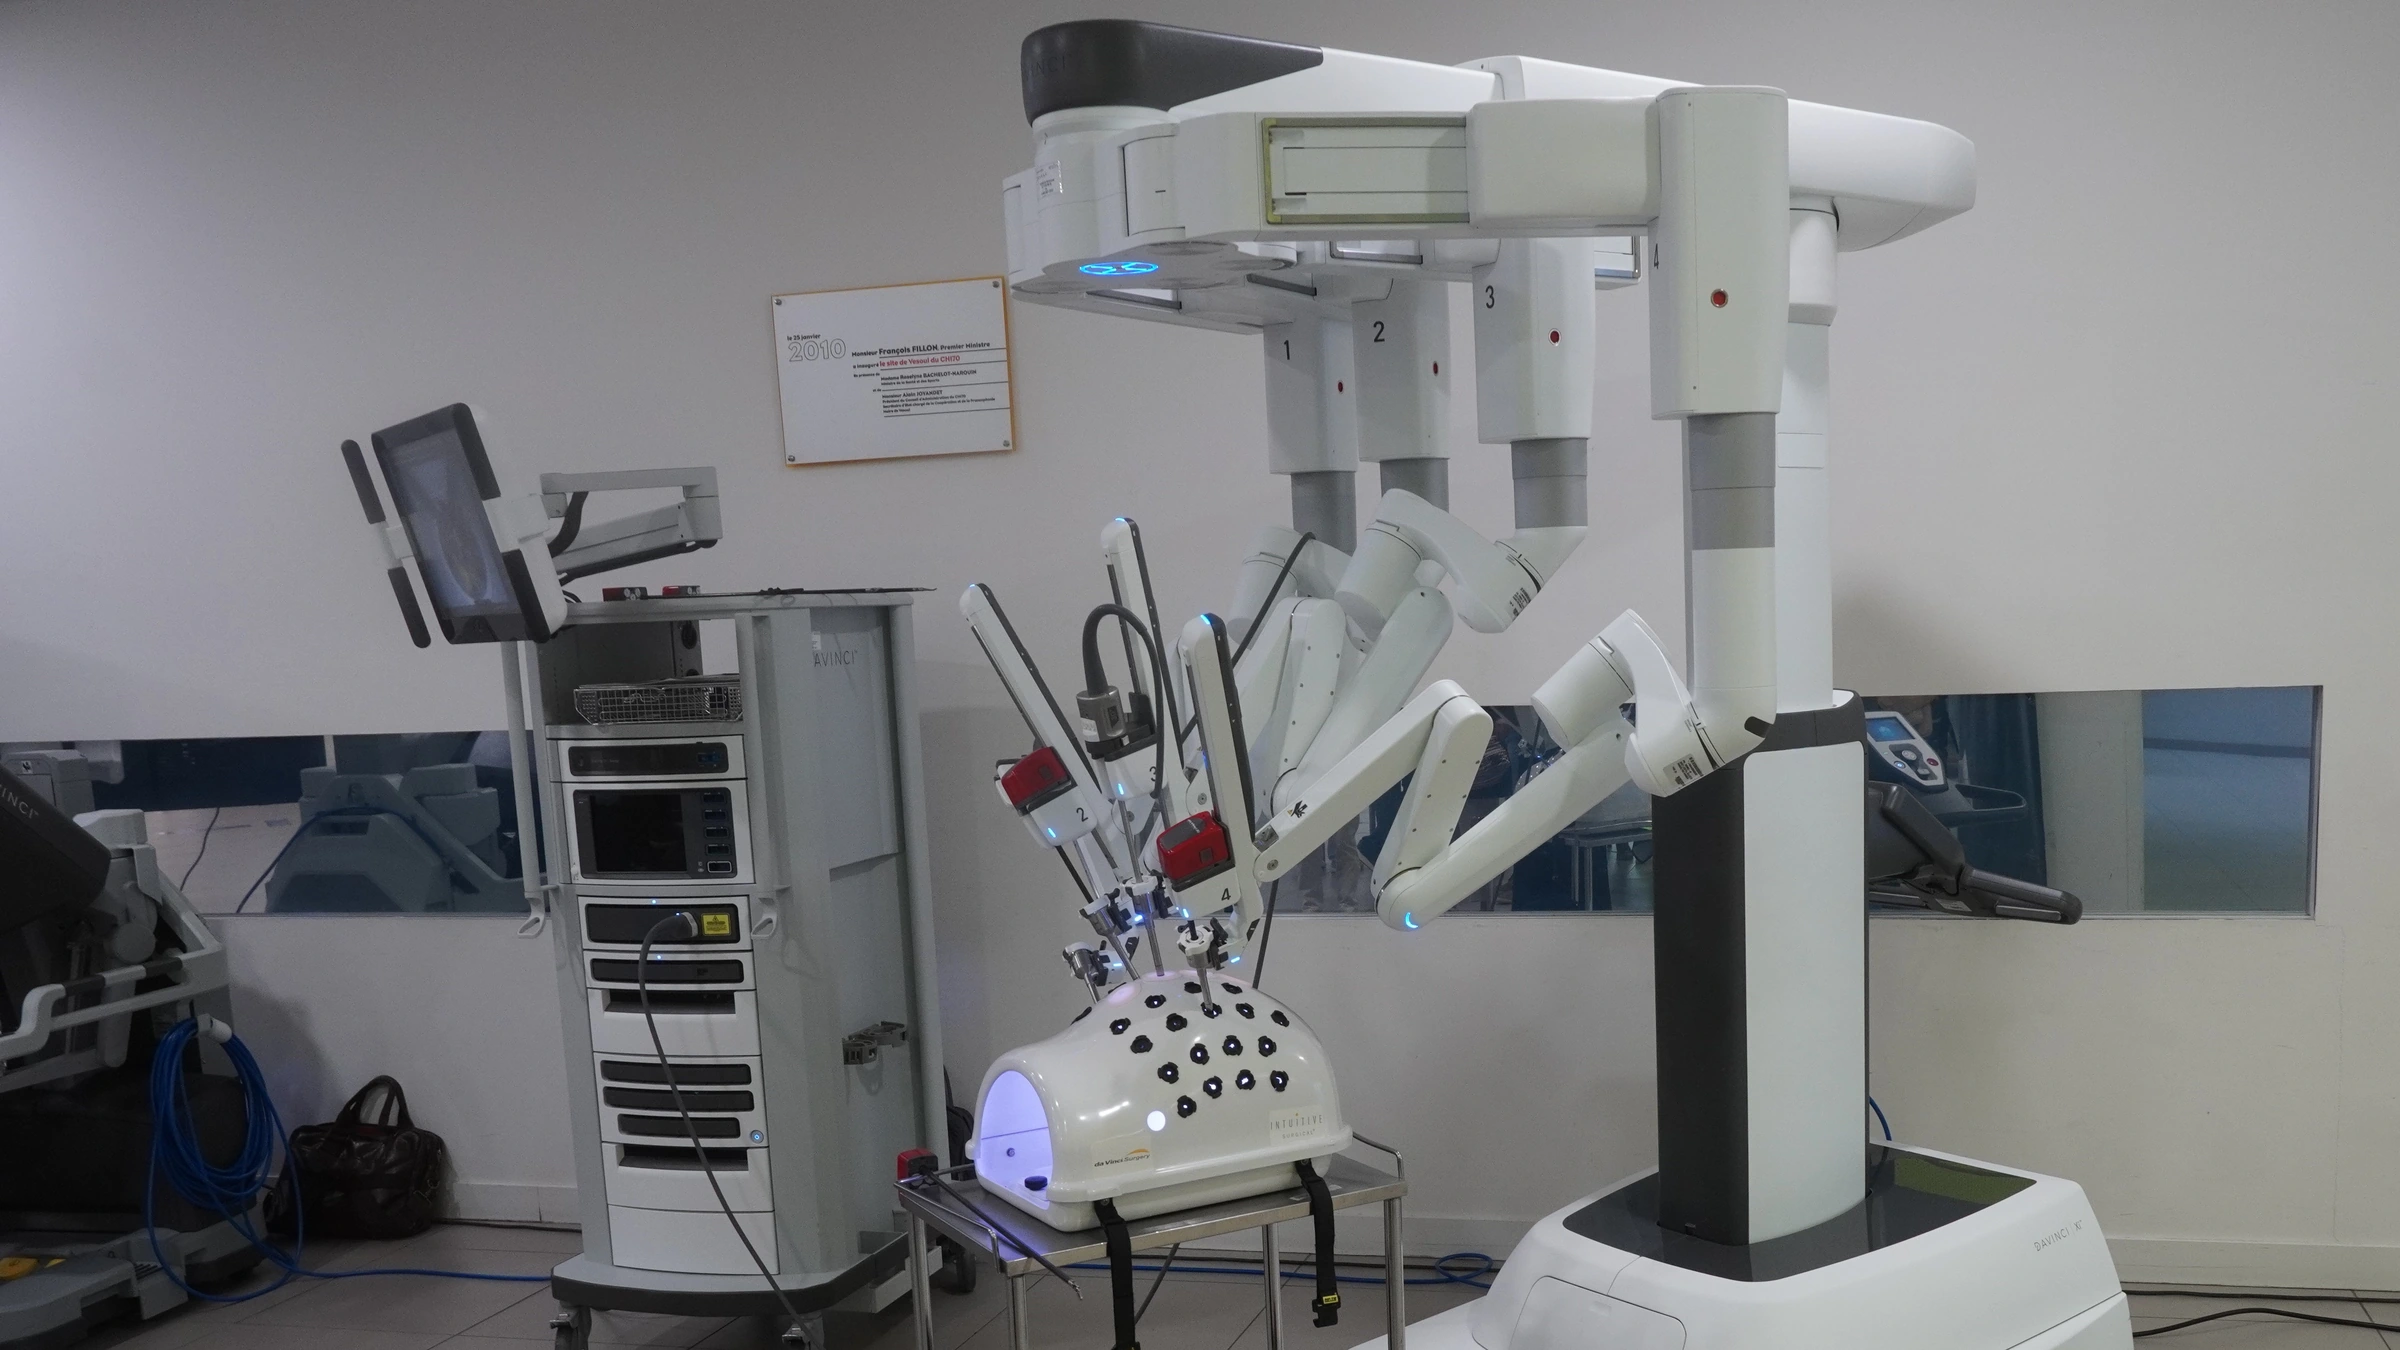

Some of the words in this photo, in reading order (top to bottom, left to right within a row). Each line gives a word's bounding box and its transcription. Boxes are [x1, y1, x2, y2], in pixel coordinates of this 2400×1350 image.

[1653, 243, 1660, 270] 4
[1485, 284, 1495, 309] 3
[801, 333, 821, 341] janvier
[1373, 320, 1385, 343] 2
[788, 337, 846, 362] 2010
[879, 346, 911, 356] François
[940, 343, 964, 351] Premier
[965, 341, 990, 349] Ministre
[1283, 339, 1290, 361] 1
[857, 362, 879, 370] inauguré
[887, 359, 898, 367] site
[899, 358, 907, 366] de
[908, 357, 929, 365] Vesoul
[813, 650, 855, 667] AVINCI
[0, 784, 33, 819] INCI
[1076, 807, 1088, 822] 2
[1221, 888, 1231, 901] 4
[1124, 1154, 1150, 1162] Surgery
[2034, 1226, 2070, 1252] DAVINCI
